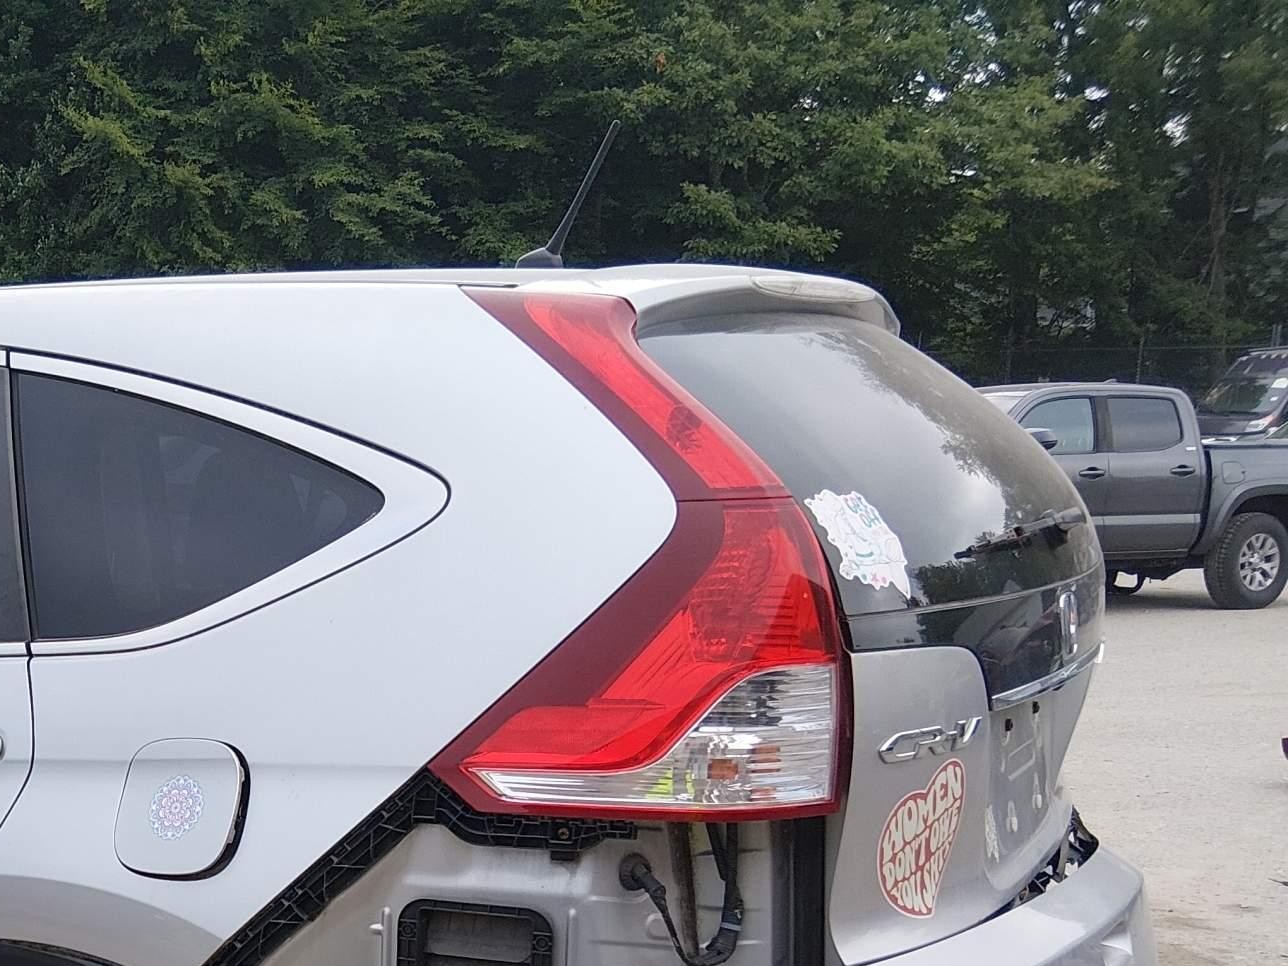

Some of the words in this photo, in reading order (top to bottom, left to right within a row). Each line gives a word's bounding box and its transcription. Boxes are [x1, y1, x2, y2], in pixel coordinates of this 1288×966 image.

[877, 716, 983, 764] CR-V
[882, 765, 962, 864] WOMEN
[883, 827, 929, 891] DON'T
[929, 799, 961, 853] OWE
[890, 870, 928, 914] YOU
